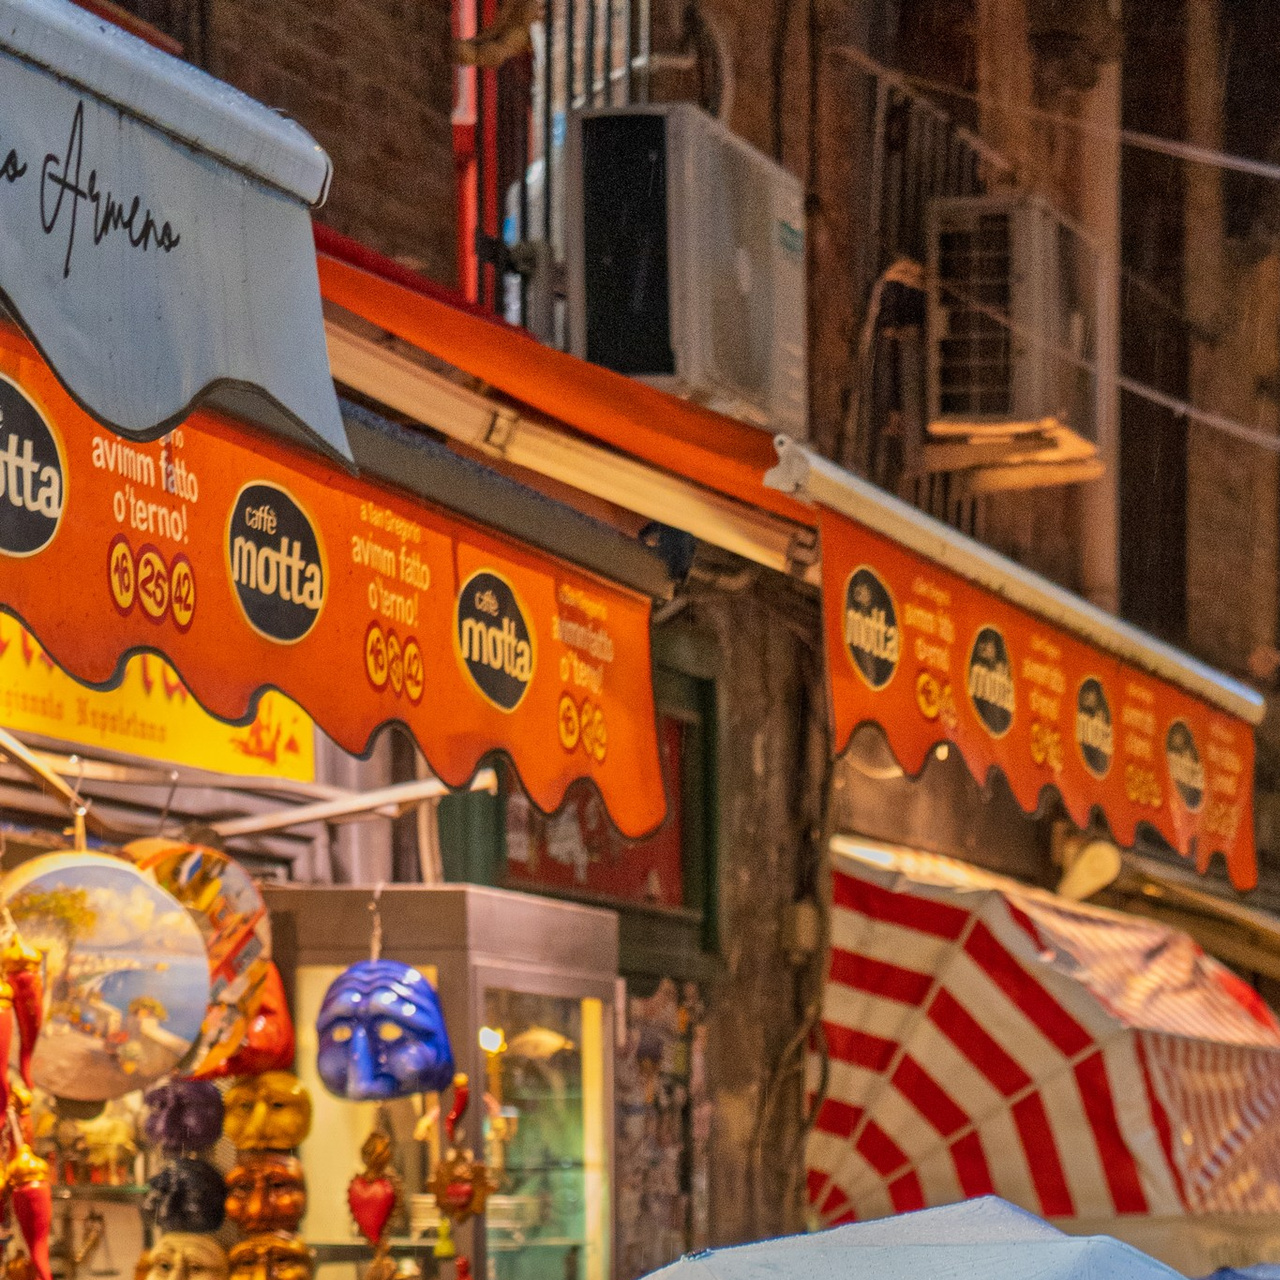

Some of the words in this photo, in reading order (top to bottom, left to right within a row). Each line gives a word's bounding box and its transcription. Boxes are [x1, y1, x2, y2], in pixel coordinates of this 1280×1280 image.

[0, 432, 60, 519] tta
[92, 434, 155, 488] avimm
[159, 449, 199, 504] fatto
[114, 552, 131, 597] 16
[140, 557, 168, 610] 25
[174, 571, 192, 613] 42
[232, 534, 322, 610] motta
[399, 545, 431, 592] fatto
[462, 616, 532, 683] motta
